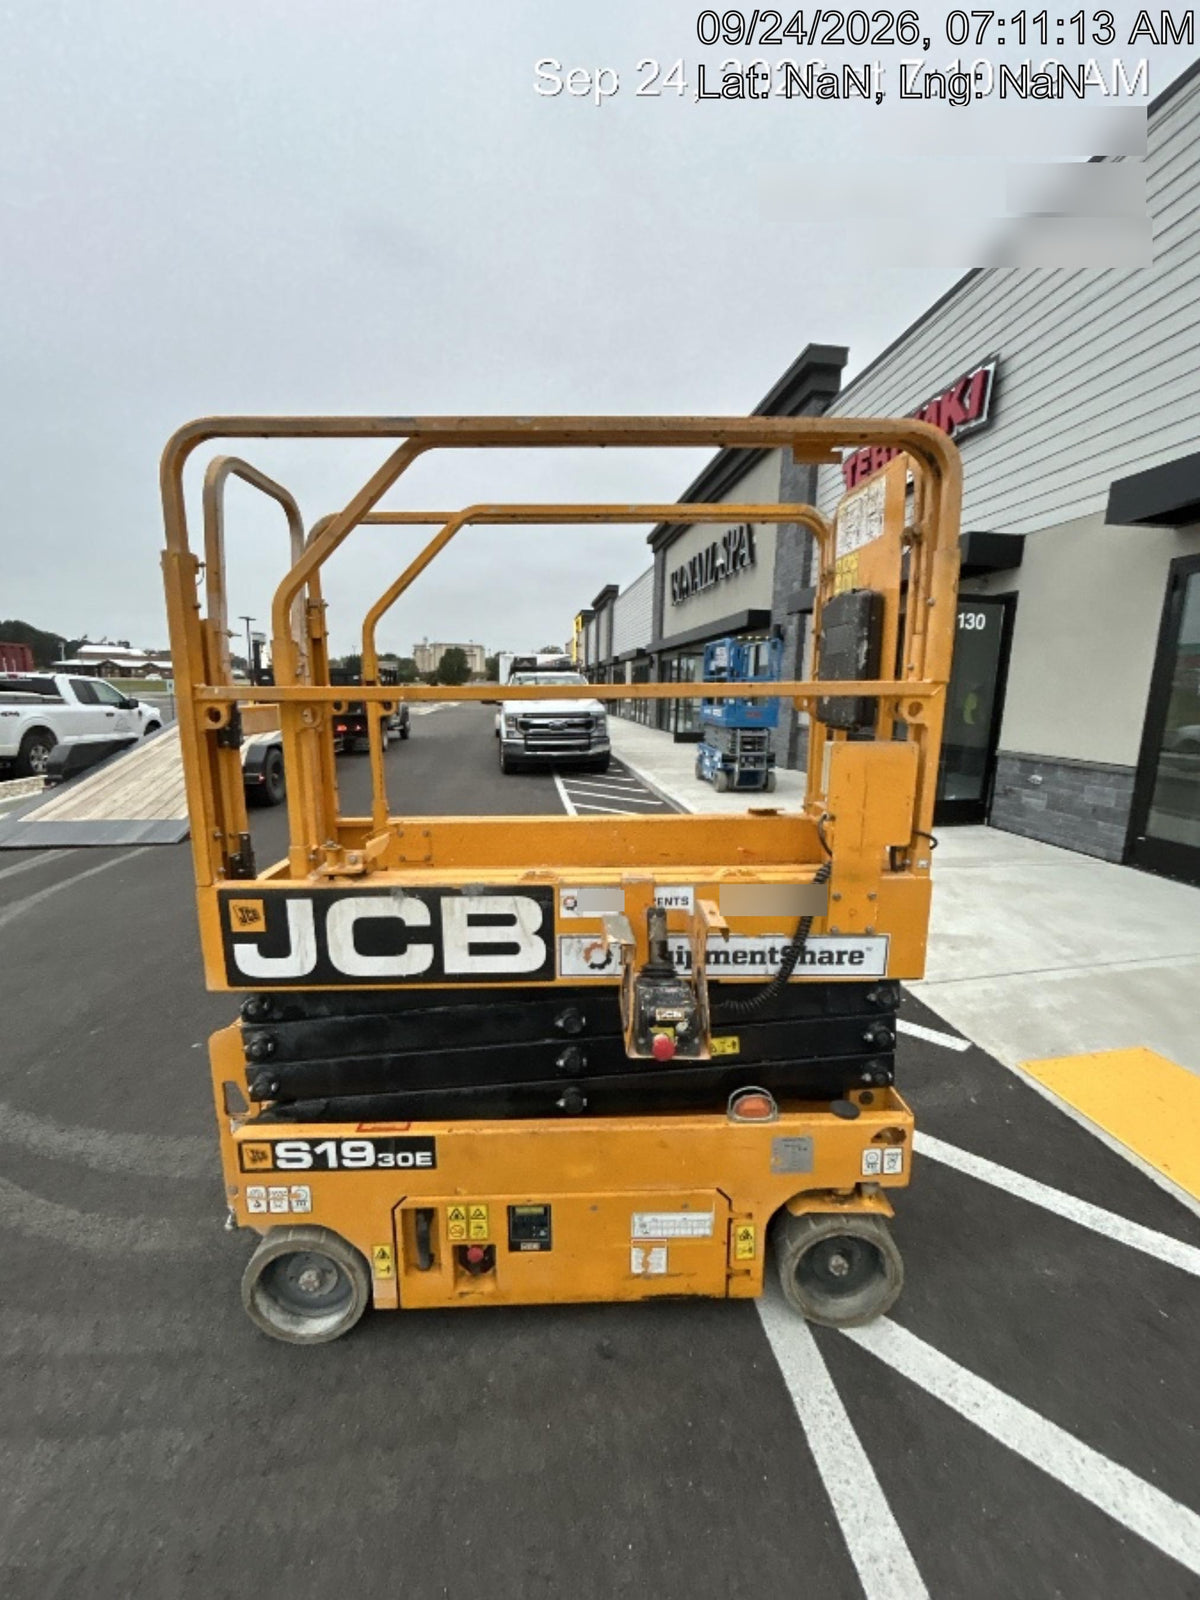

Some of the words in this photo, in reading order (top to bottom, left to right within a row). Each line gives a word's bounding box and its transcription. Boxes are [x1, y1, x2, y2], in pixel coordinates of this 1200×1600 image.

[842, 369, 989, 491] TERAKI
[958, 612, 986, 630] 130
[653, 896, 689, 906] ENTS
[233, 895, 547, 978] JCB
